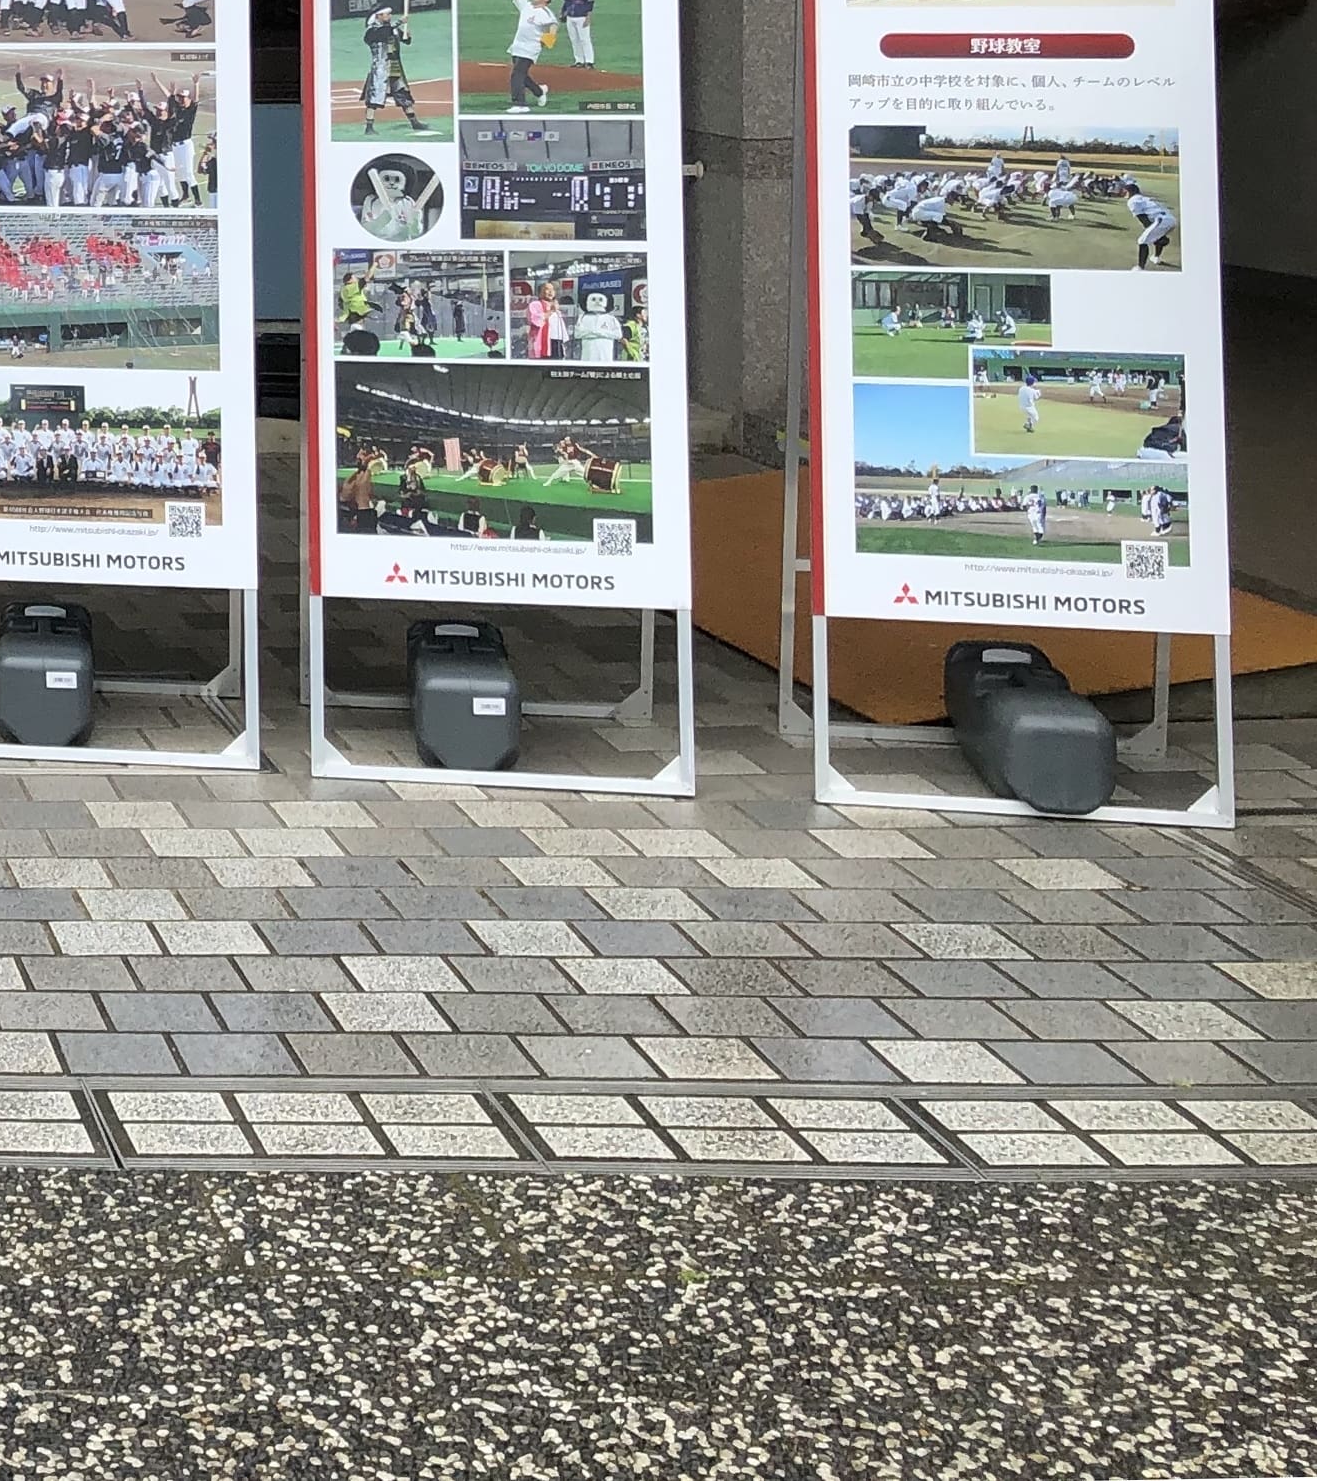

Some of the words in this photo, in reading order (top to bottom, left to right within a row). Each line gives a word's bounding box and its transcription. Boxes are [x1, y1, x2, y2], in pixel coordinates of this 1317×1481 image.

[970, 36, 1041, 55] 野球教室
[848, 73, 1176, 90] 岡崎市立の中学校を対象に、個人、チームのレベル
[848, 97, 1056, 112] アップを目的に取り組んでいる。
[526, 163, 557, 173] TOKYO
[558, 163, 584, 172] DOME
[599, 161, 631, 169] ENEOS
[107, 554, 186, 571] MOTORS
[413, 569, 525, 588] MITSUBISHI
[532, 573, 615, 591] MOTORS
[924, 590, 1046, 611] MITSUBISHI
[1054, 596, 1146, 615] MOTORS
